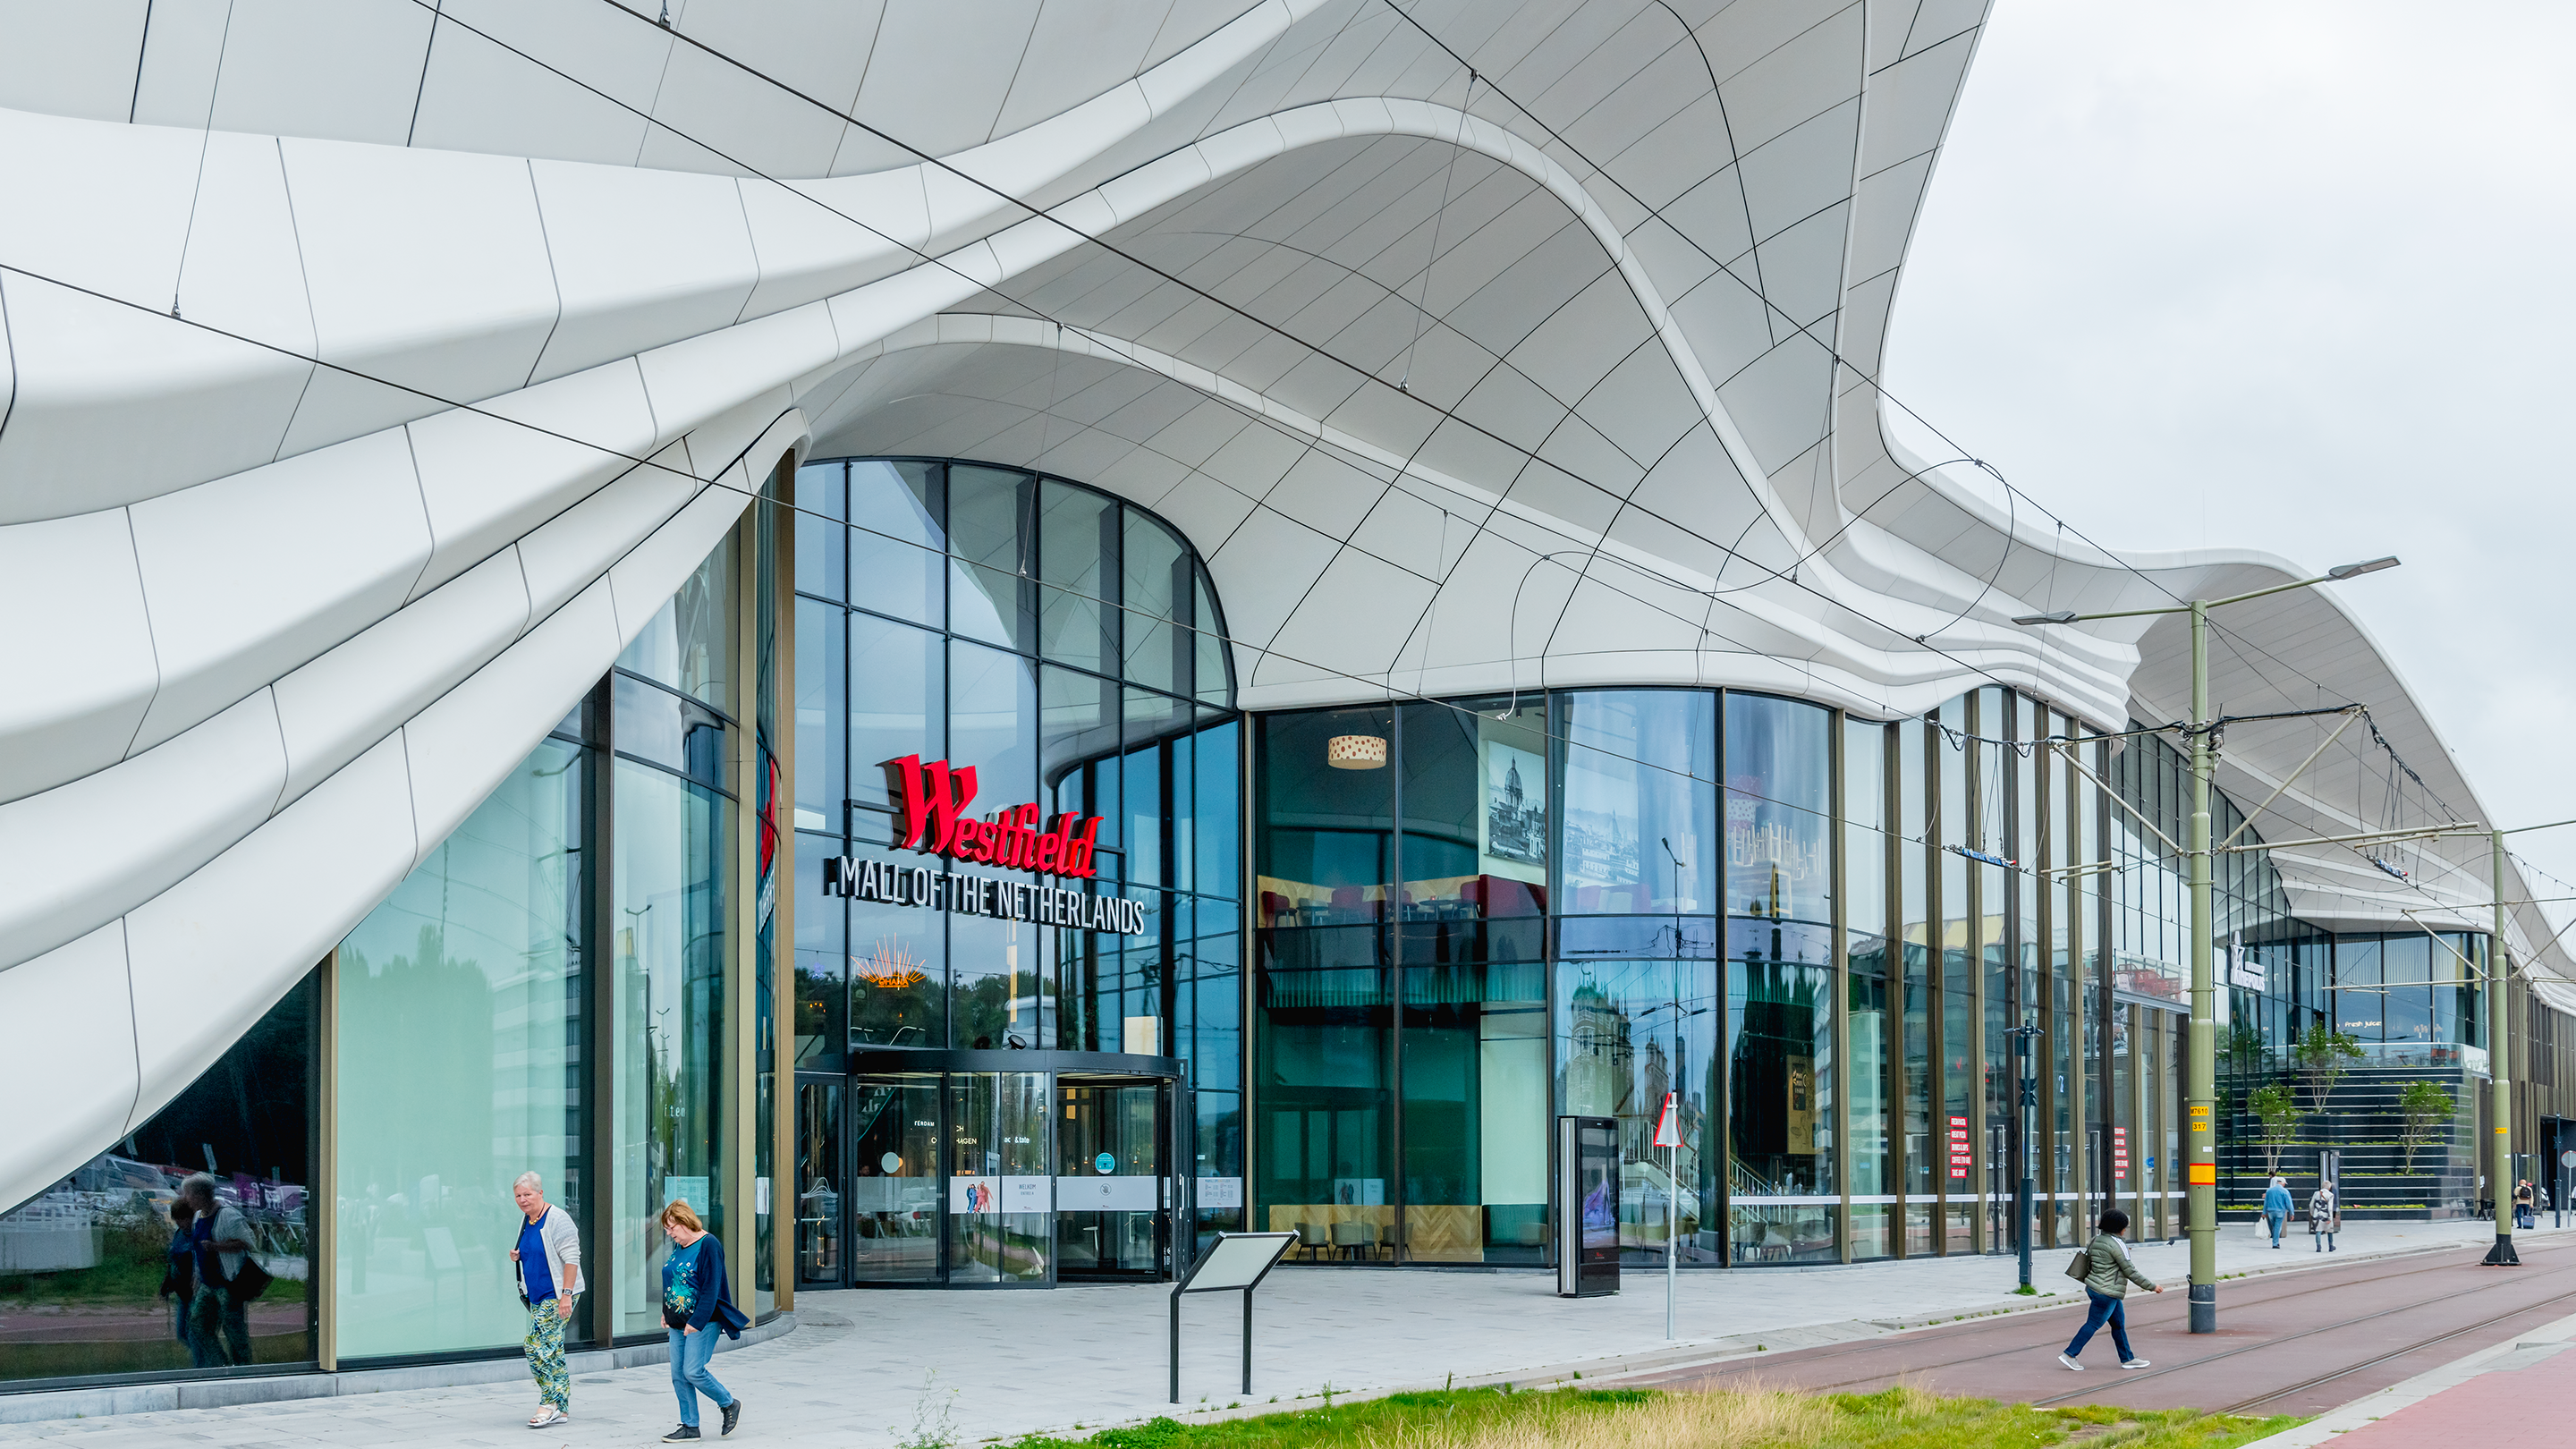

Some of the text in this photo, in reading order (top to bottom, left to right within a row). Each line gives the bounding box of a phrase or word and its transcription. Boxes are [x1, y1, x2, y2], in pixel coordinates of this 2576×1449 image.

[889, 753, 1105, 878] Westfield
[840, 855, 1145, 935] MALL OF THE NETHERLANDS
